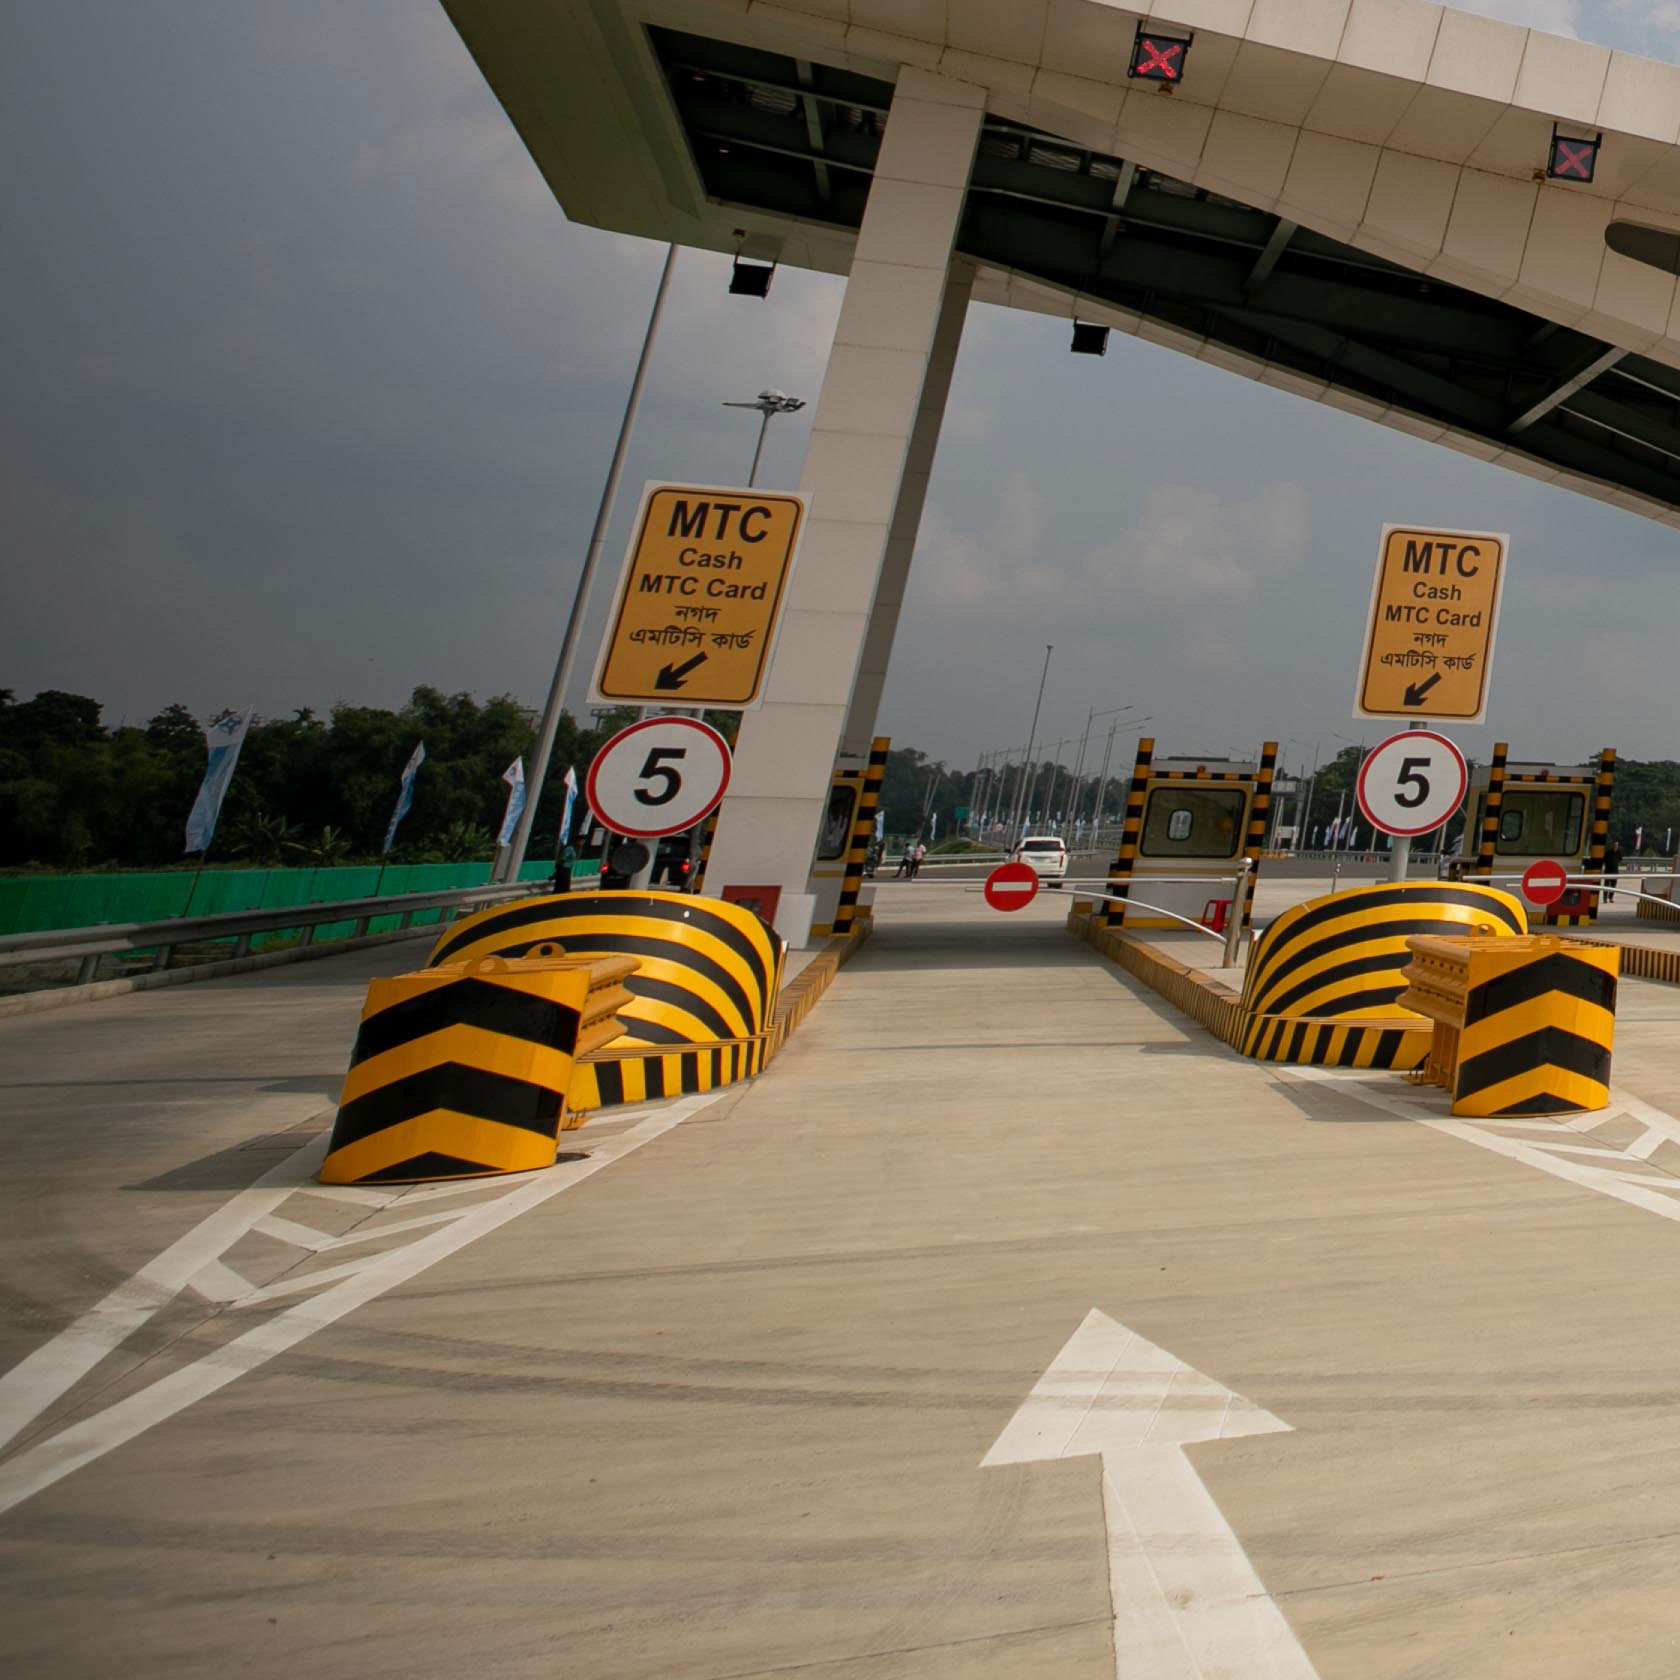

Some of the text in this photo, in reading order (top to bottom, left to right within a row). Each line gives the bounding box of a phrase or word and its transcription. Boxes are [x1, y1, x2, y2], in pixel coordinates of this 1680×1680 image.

[668, 501, 771, 543] MTC
[679, 548, 742, 569] Cash
[1403, 540, 1480, 577] MTC
[640, 574, 767, 600] MTC Card
[1413, 582, 1461, 600] Cash
[675, 606, 721, 623] নগদ
[1386, 605, 1481, 627] MTC Card
[630, 625, 755, 649] এমটিসি কার্ড
[1413, 633, 1448, 647] নগদ
[1381, 650, 1476, 670] এমটিসি কার্ড
[634, 748, 686, 806] 5
[1394, 758, 1431, 808] 5
